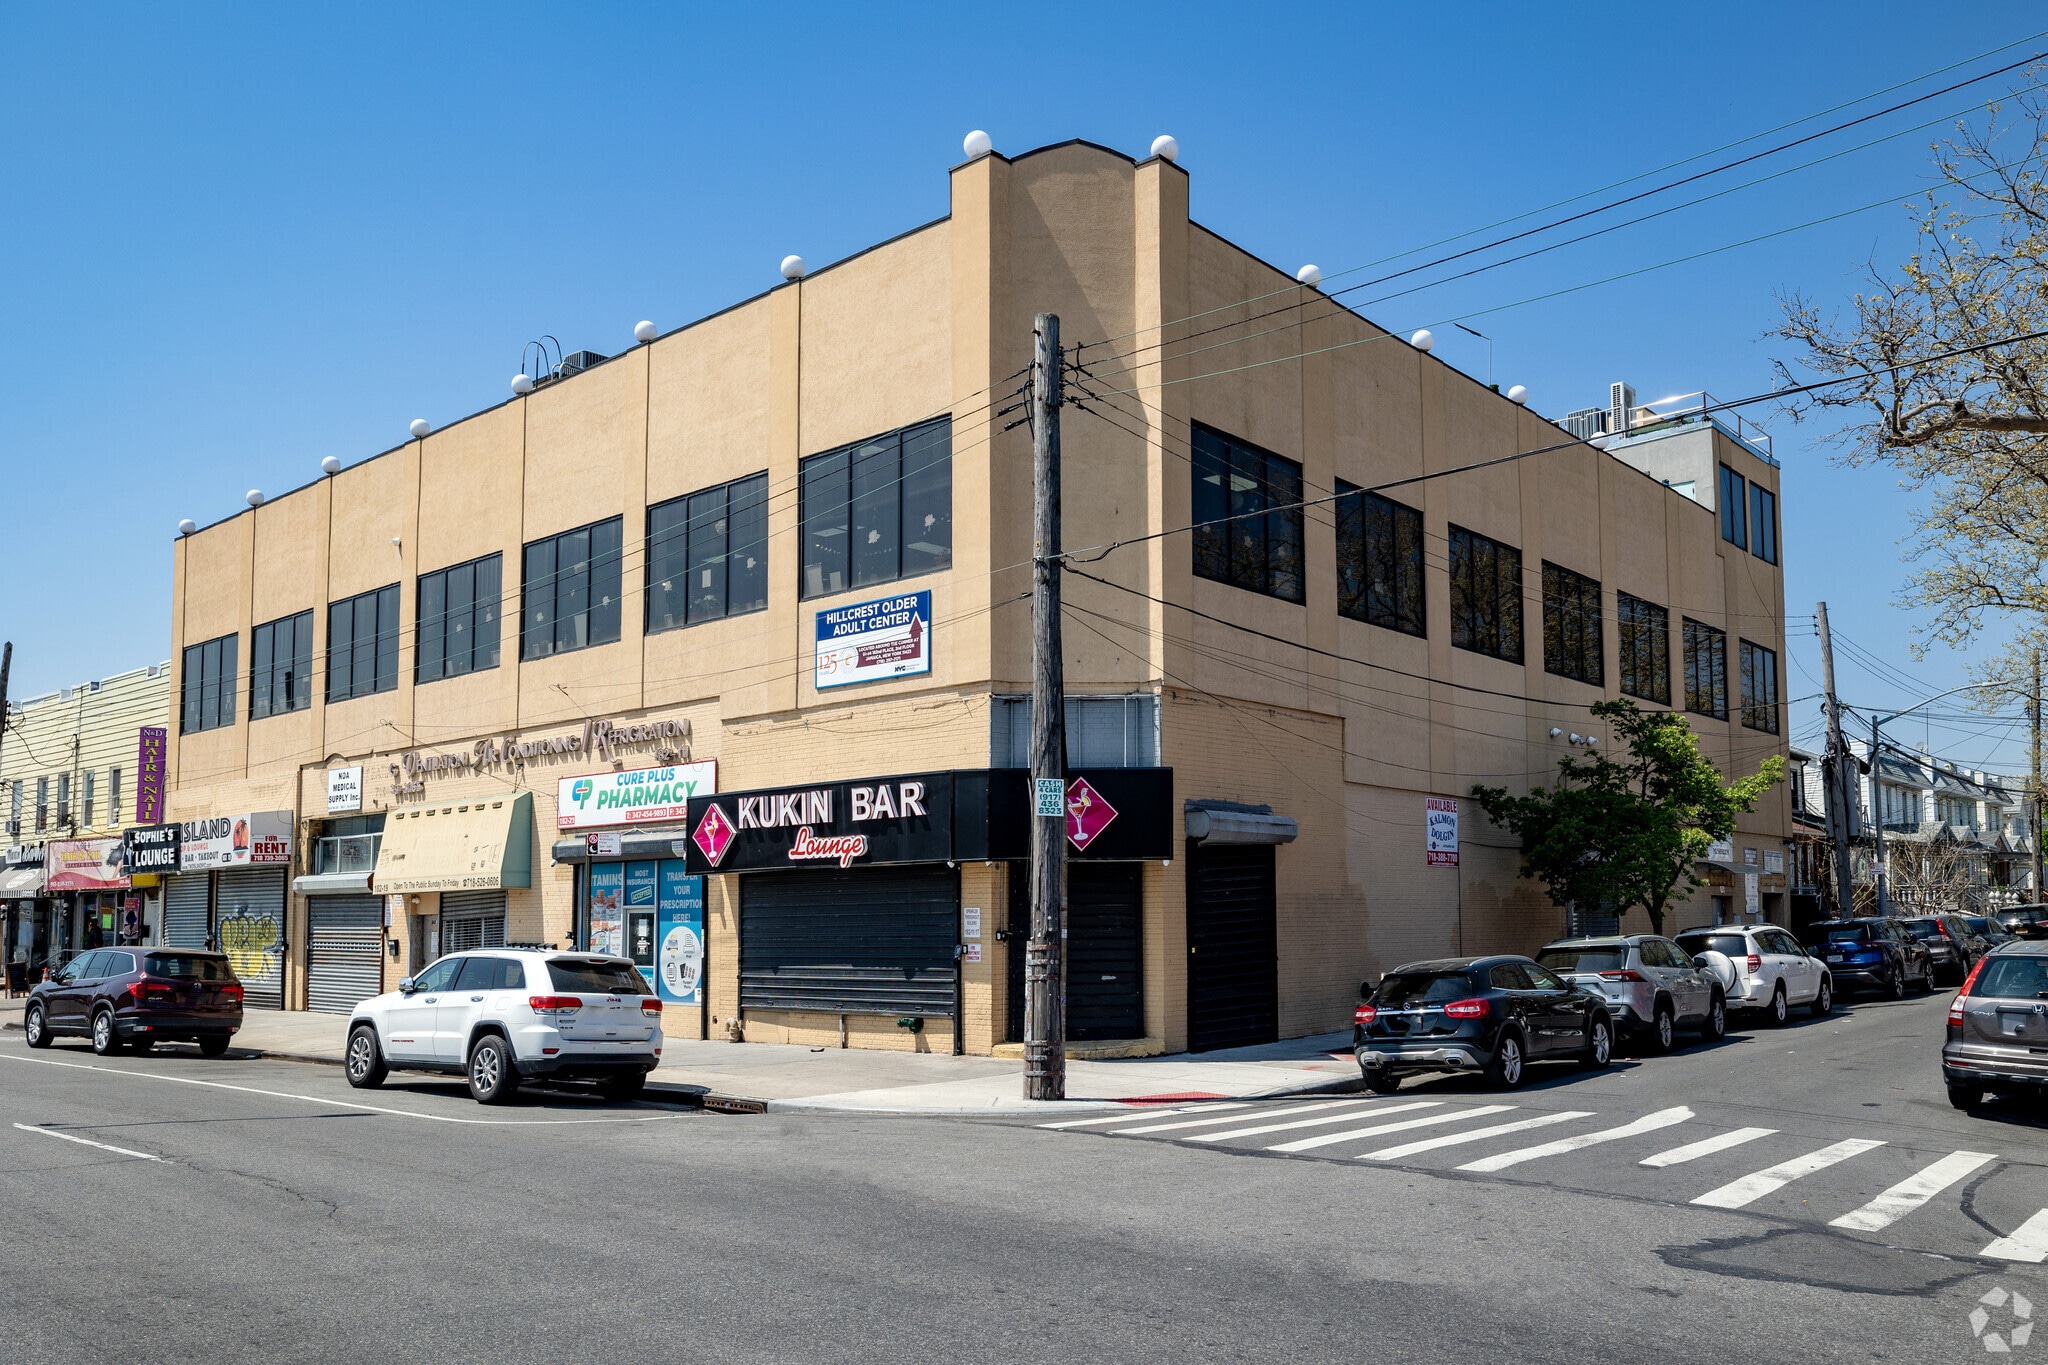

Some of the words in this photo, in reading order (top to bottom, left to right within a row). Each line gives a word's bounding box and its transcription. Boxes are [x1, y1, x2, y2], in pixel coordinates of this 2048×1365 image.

[826, 604, 880, 624] HILLCREST
[882, 596, 918, 613] OLDER
[833, 620, 866, 636] ADULT
[868, 612, 910, 630] CENTER
[144, 738, 160, 772] HAIR
[617, 771, 646, 786] CURE
[647, 768, 675, 783] PLUS
[332, 782, 356, 792] MEDICAL
[596, 780, 698, 810] PHARMACY
[143, 786, 158, 820] NAIL
[328, 794, 349, 803] SUPPLY
[738, 790, 833, 830] KUKIN
[850, 782, 926, 822] BAR
[1427, 799, 1457, 813] AVAILABLE
[1429, 814, 1456, 828] KALMON
[134, 826, 174, 844] SOPHIE'S
[181, 817, 231, 843] ISLAND
[1431, 827, 1454, 841] DOLGIN
[254, 843, 288, 854] RENT
[788, 826, 868, 868] Lounge
[135, 848, 175, 867] LOUNGE
[185, 853, 194, 862] BAR
[393, 882, 403, 890] Open
[404, 881, 408, 889] To
[416, 880, 427, 889] Public
[428, 880, 441, 889] Sunday
[447, 879, 459, 888] Friday
[591, 873, 622, 886] TAMINS
[673, 885, 691, 895] YOUR
[672, 913, 691, 923] HERE!
